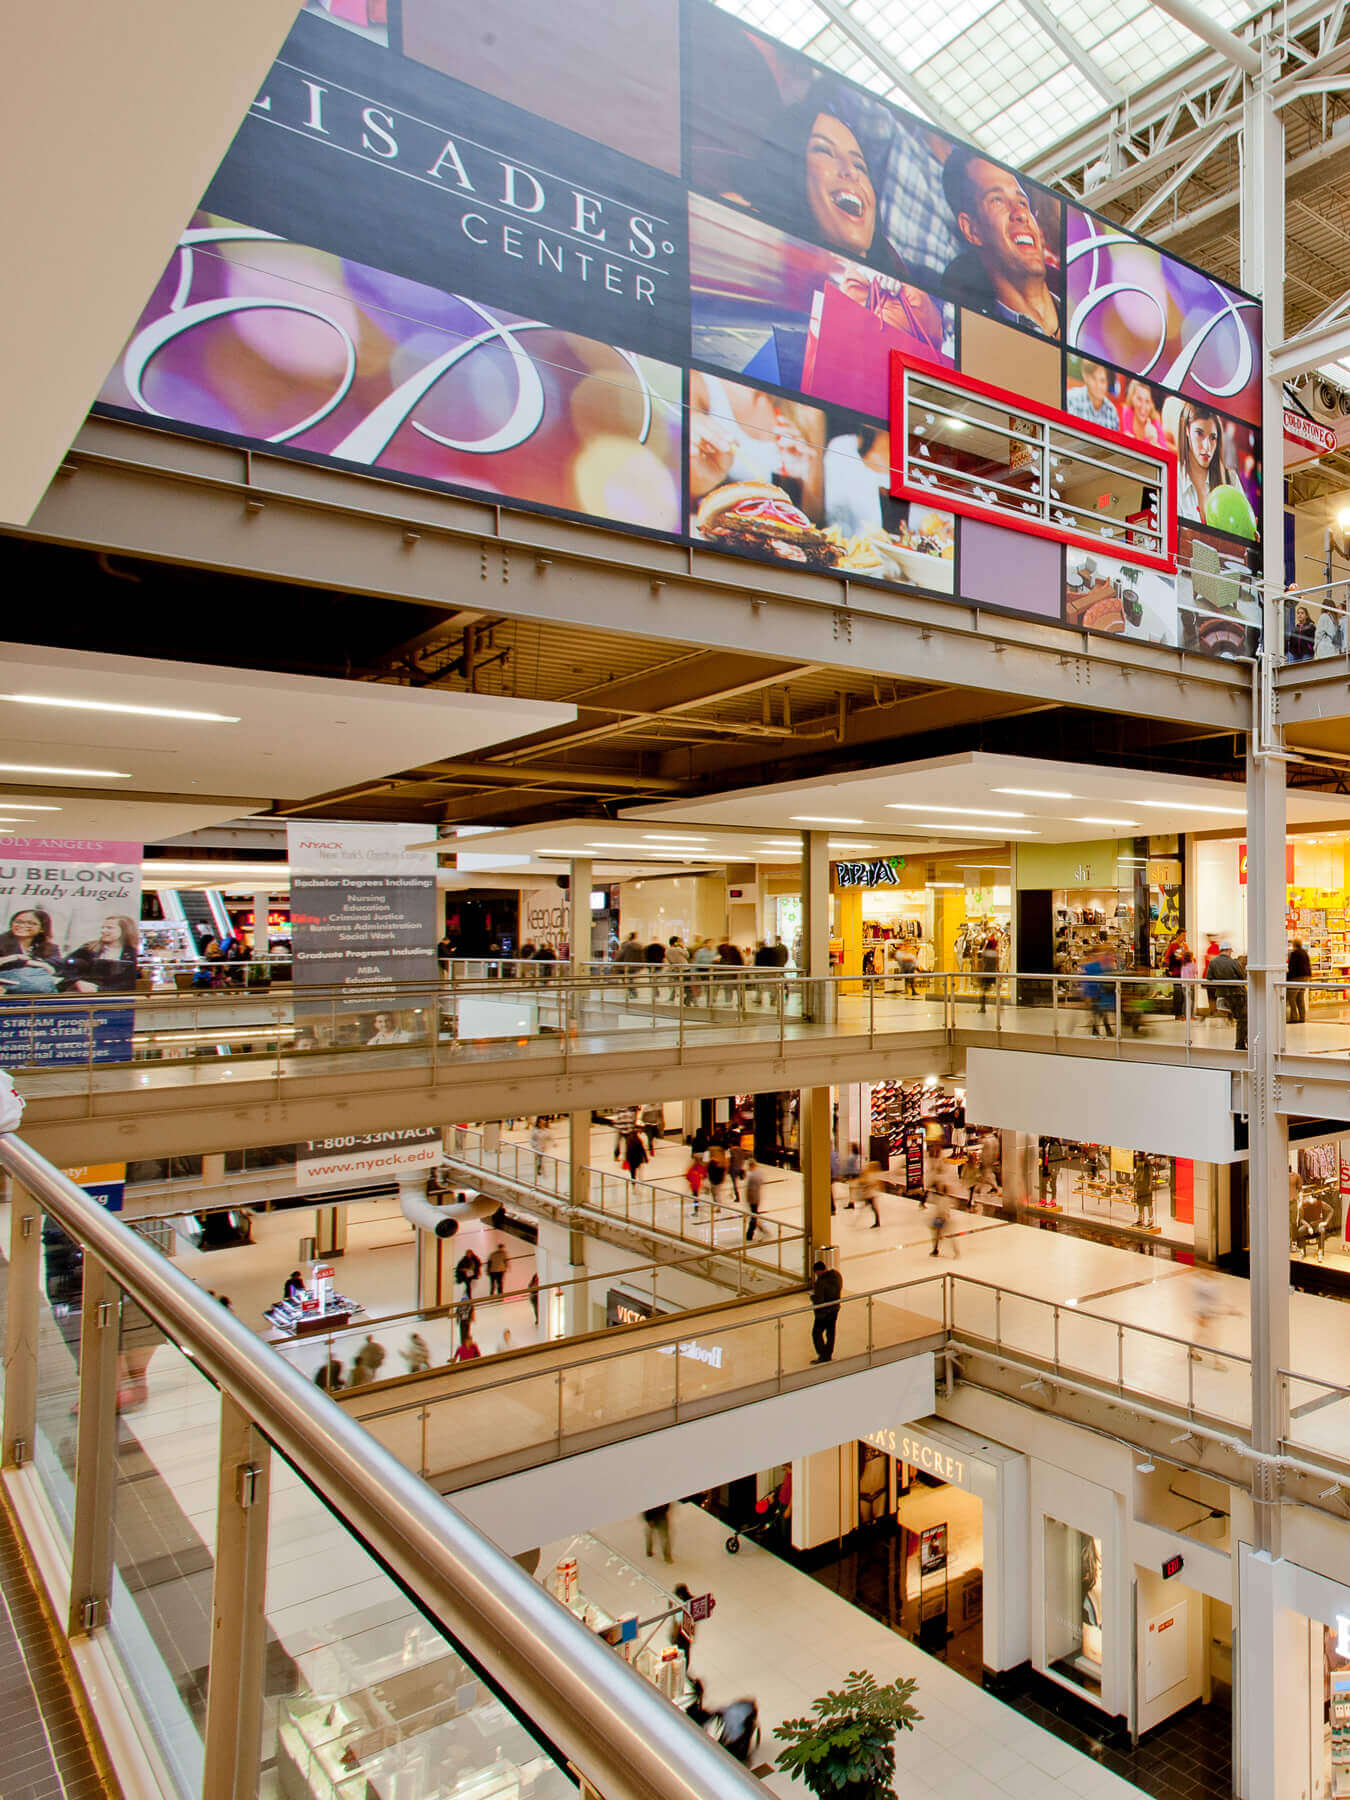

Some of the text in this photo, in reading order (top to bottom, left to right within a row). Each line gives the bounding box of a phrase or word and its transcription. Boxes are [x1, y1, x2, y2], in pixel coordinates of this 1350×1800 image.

[460, 213, 656, 305] CENTER
[1303, 421, 1325, 443] STONE
[40, 839, 104, 850] ANGELS
[299, 841, 343, 849] NYACK
[26, 868, 134, 883] BELONG
[294, 879, 433, 889] Bachelor Degrees Including:
[21, 884, 68, 900] Holy
[71, 886, 130, 902] Angels
[347, 895, 386, 903] Nursing
[373, 913, 404, 921] Justice
[354, 921, 422, 930] Administration
[338, 932, 395, 941] Social Work
[297, 951, 343, 960] Graduate
[344, 950, 390, 959] Programs
[357, 966, 380, 974] MBA
[344, 976, 393, 984] Education
[3, 1018, 54, 1028] STREAM
[306, 1127, 436, 1151] 1-800-33NYACK
[307, 1150, 435, 1176] www.nyack.edu
[903, 1437, 966, 1484] SECRET
